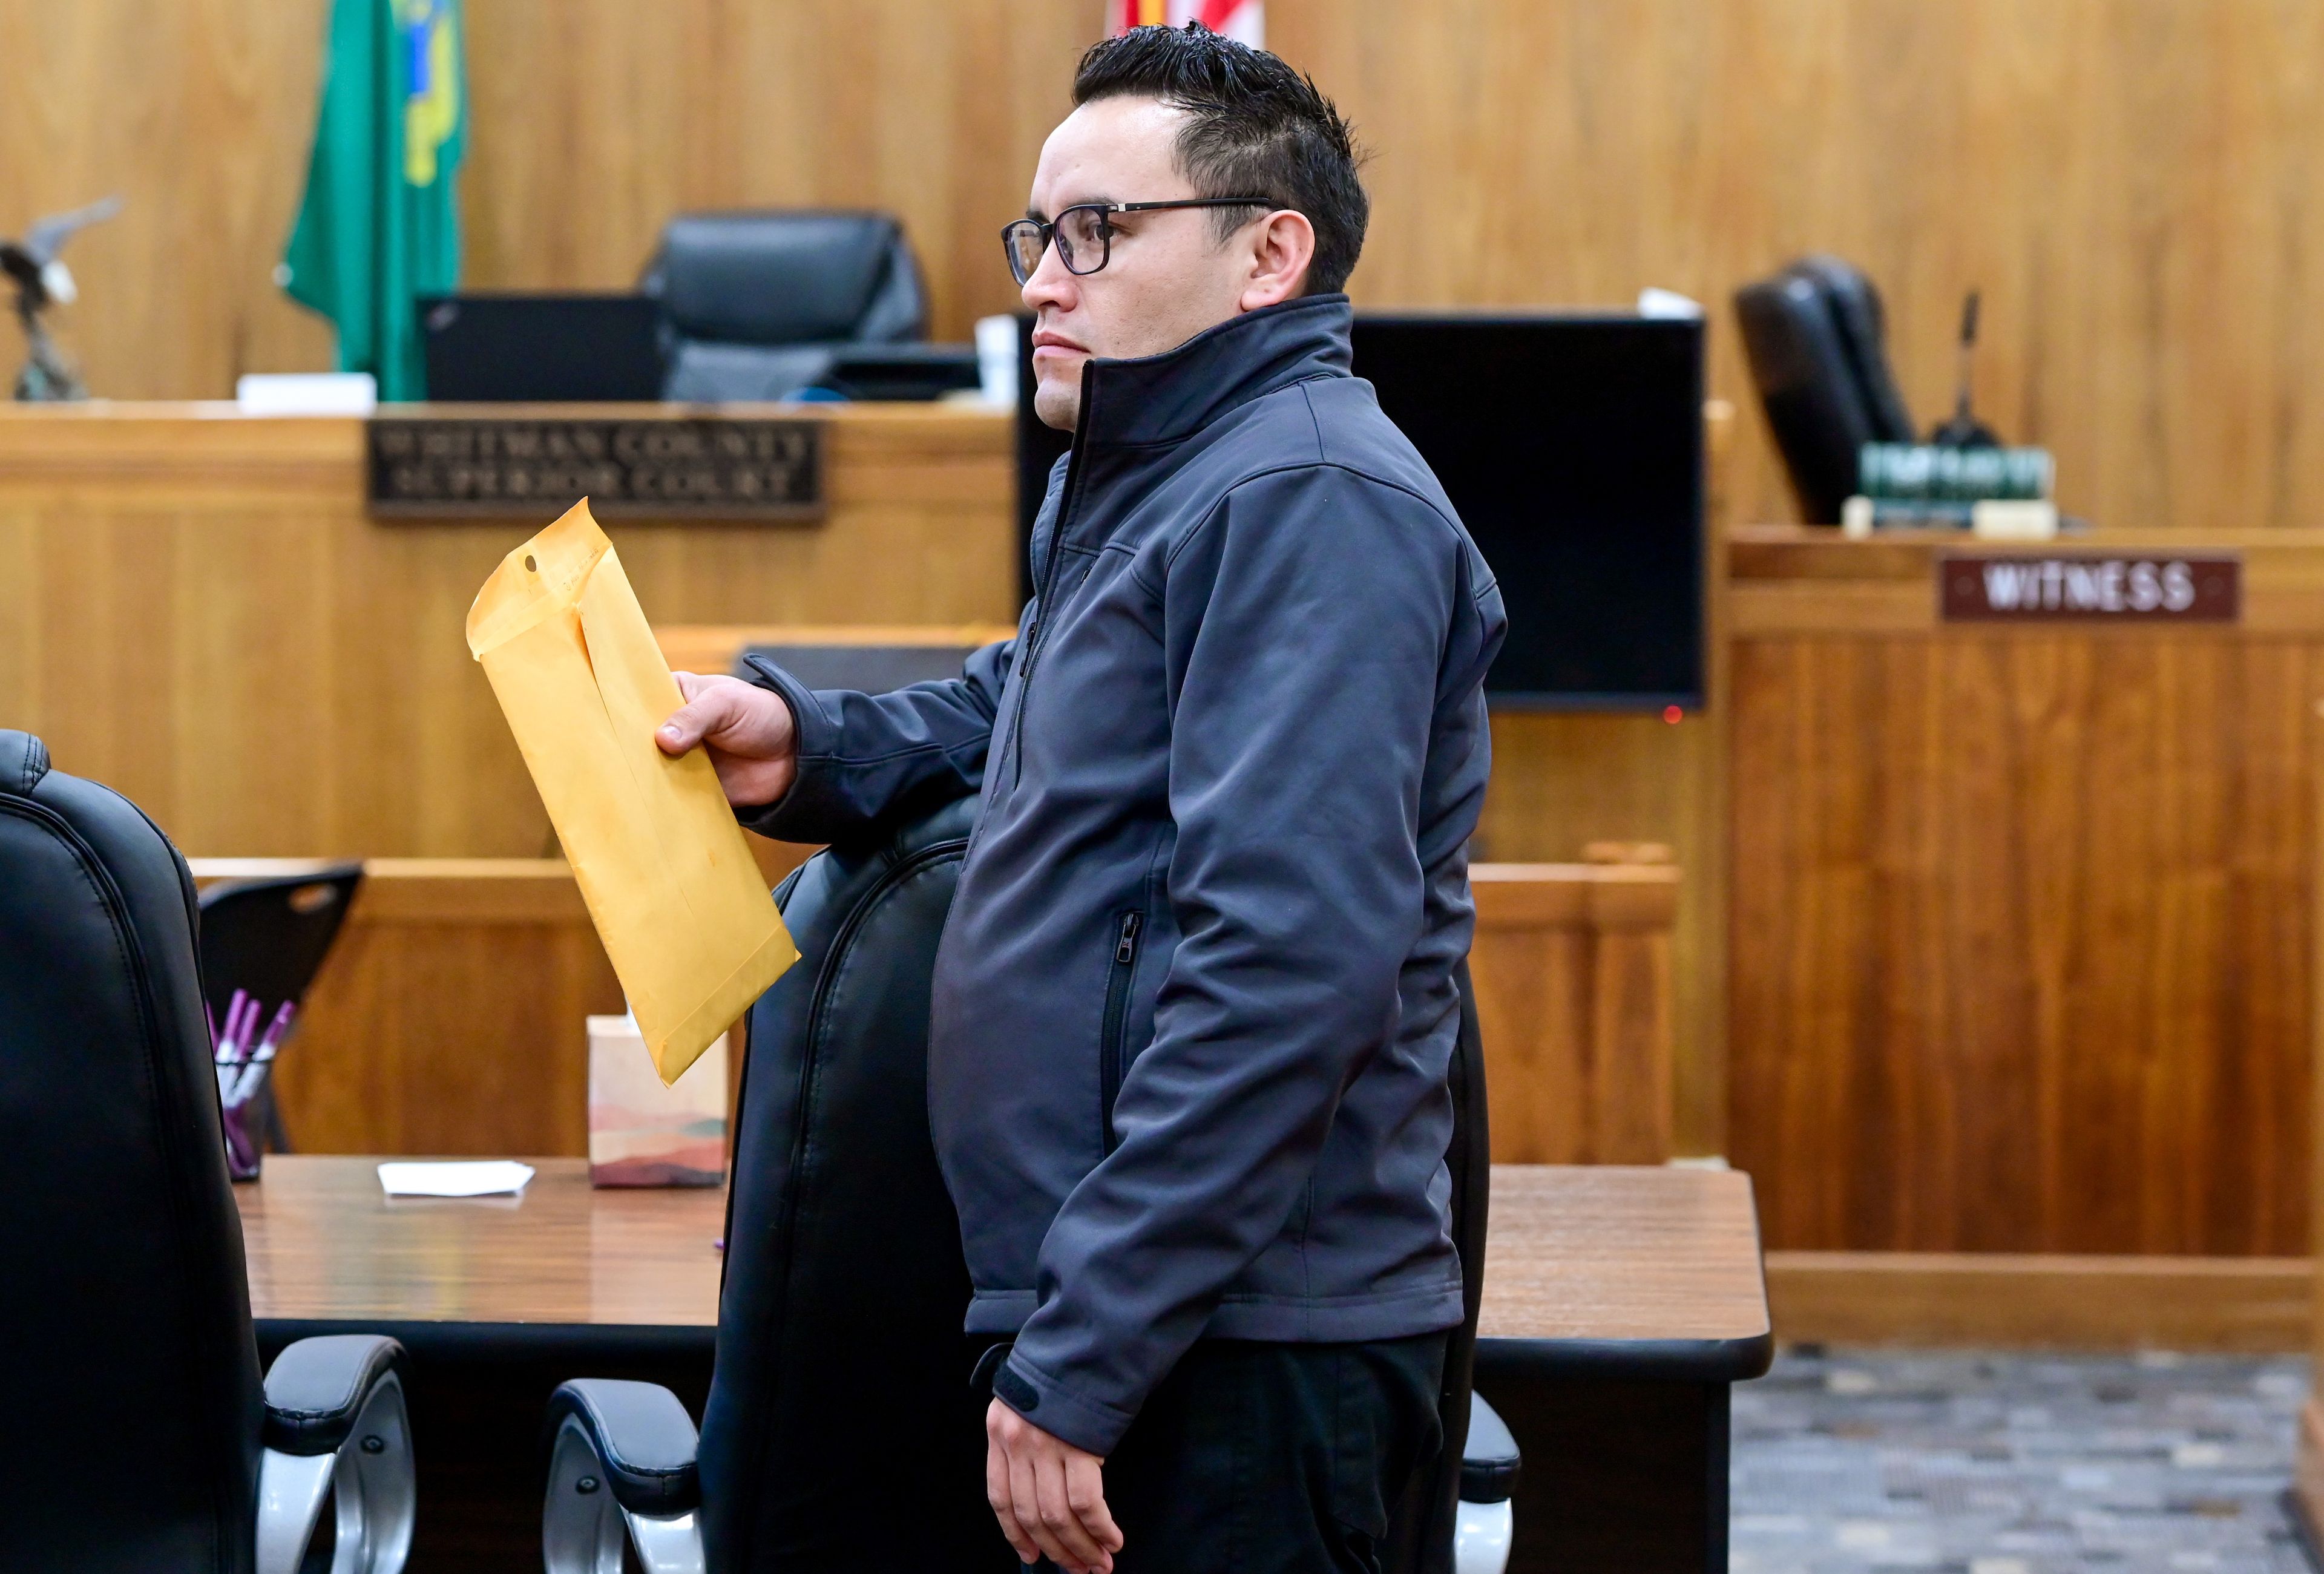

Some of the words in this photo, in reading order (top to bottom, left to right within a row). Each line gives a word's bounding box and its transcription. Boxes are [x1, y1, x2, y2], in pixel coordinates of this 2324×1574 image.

[614, 428, 807, 459] COUNTY
[392, 465, 621, 496] SUPERIOR
[631, 466, 792, 496] COURT
[1982, 560, 2195, 611] WITNESS
